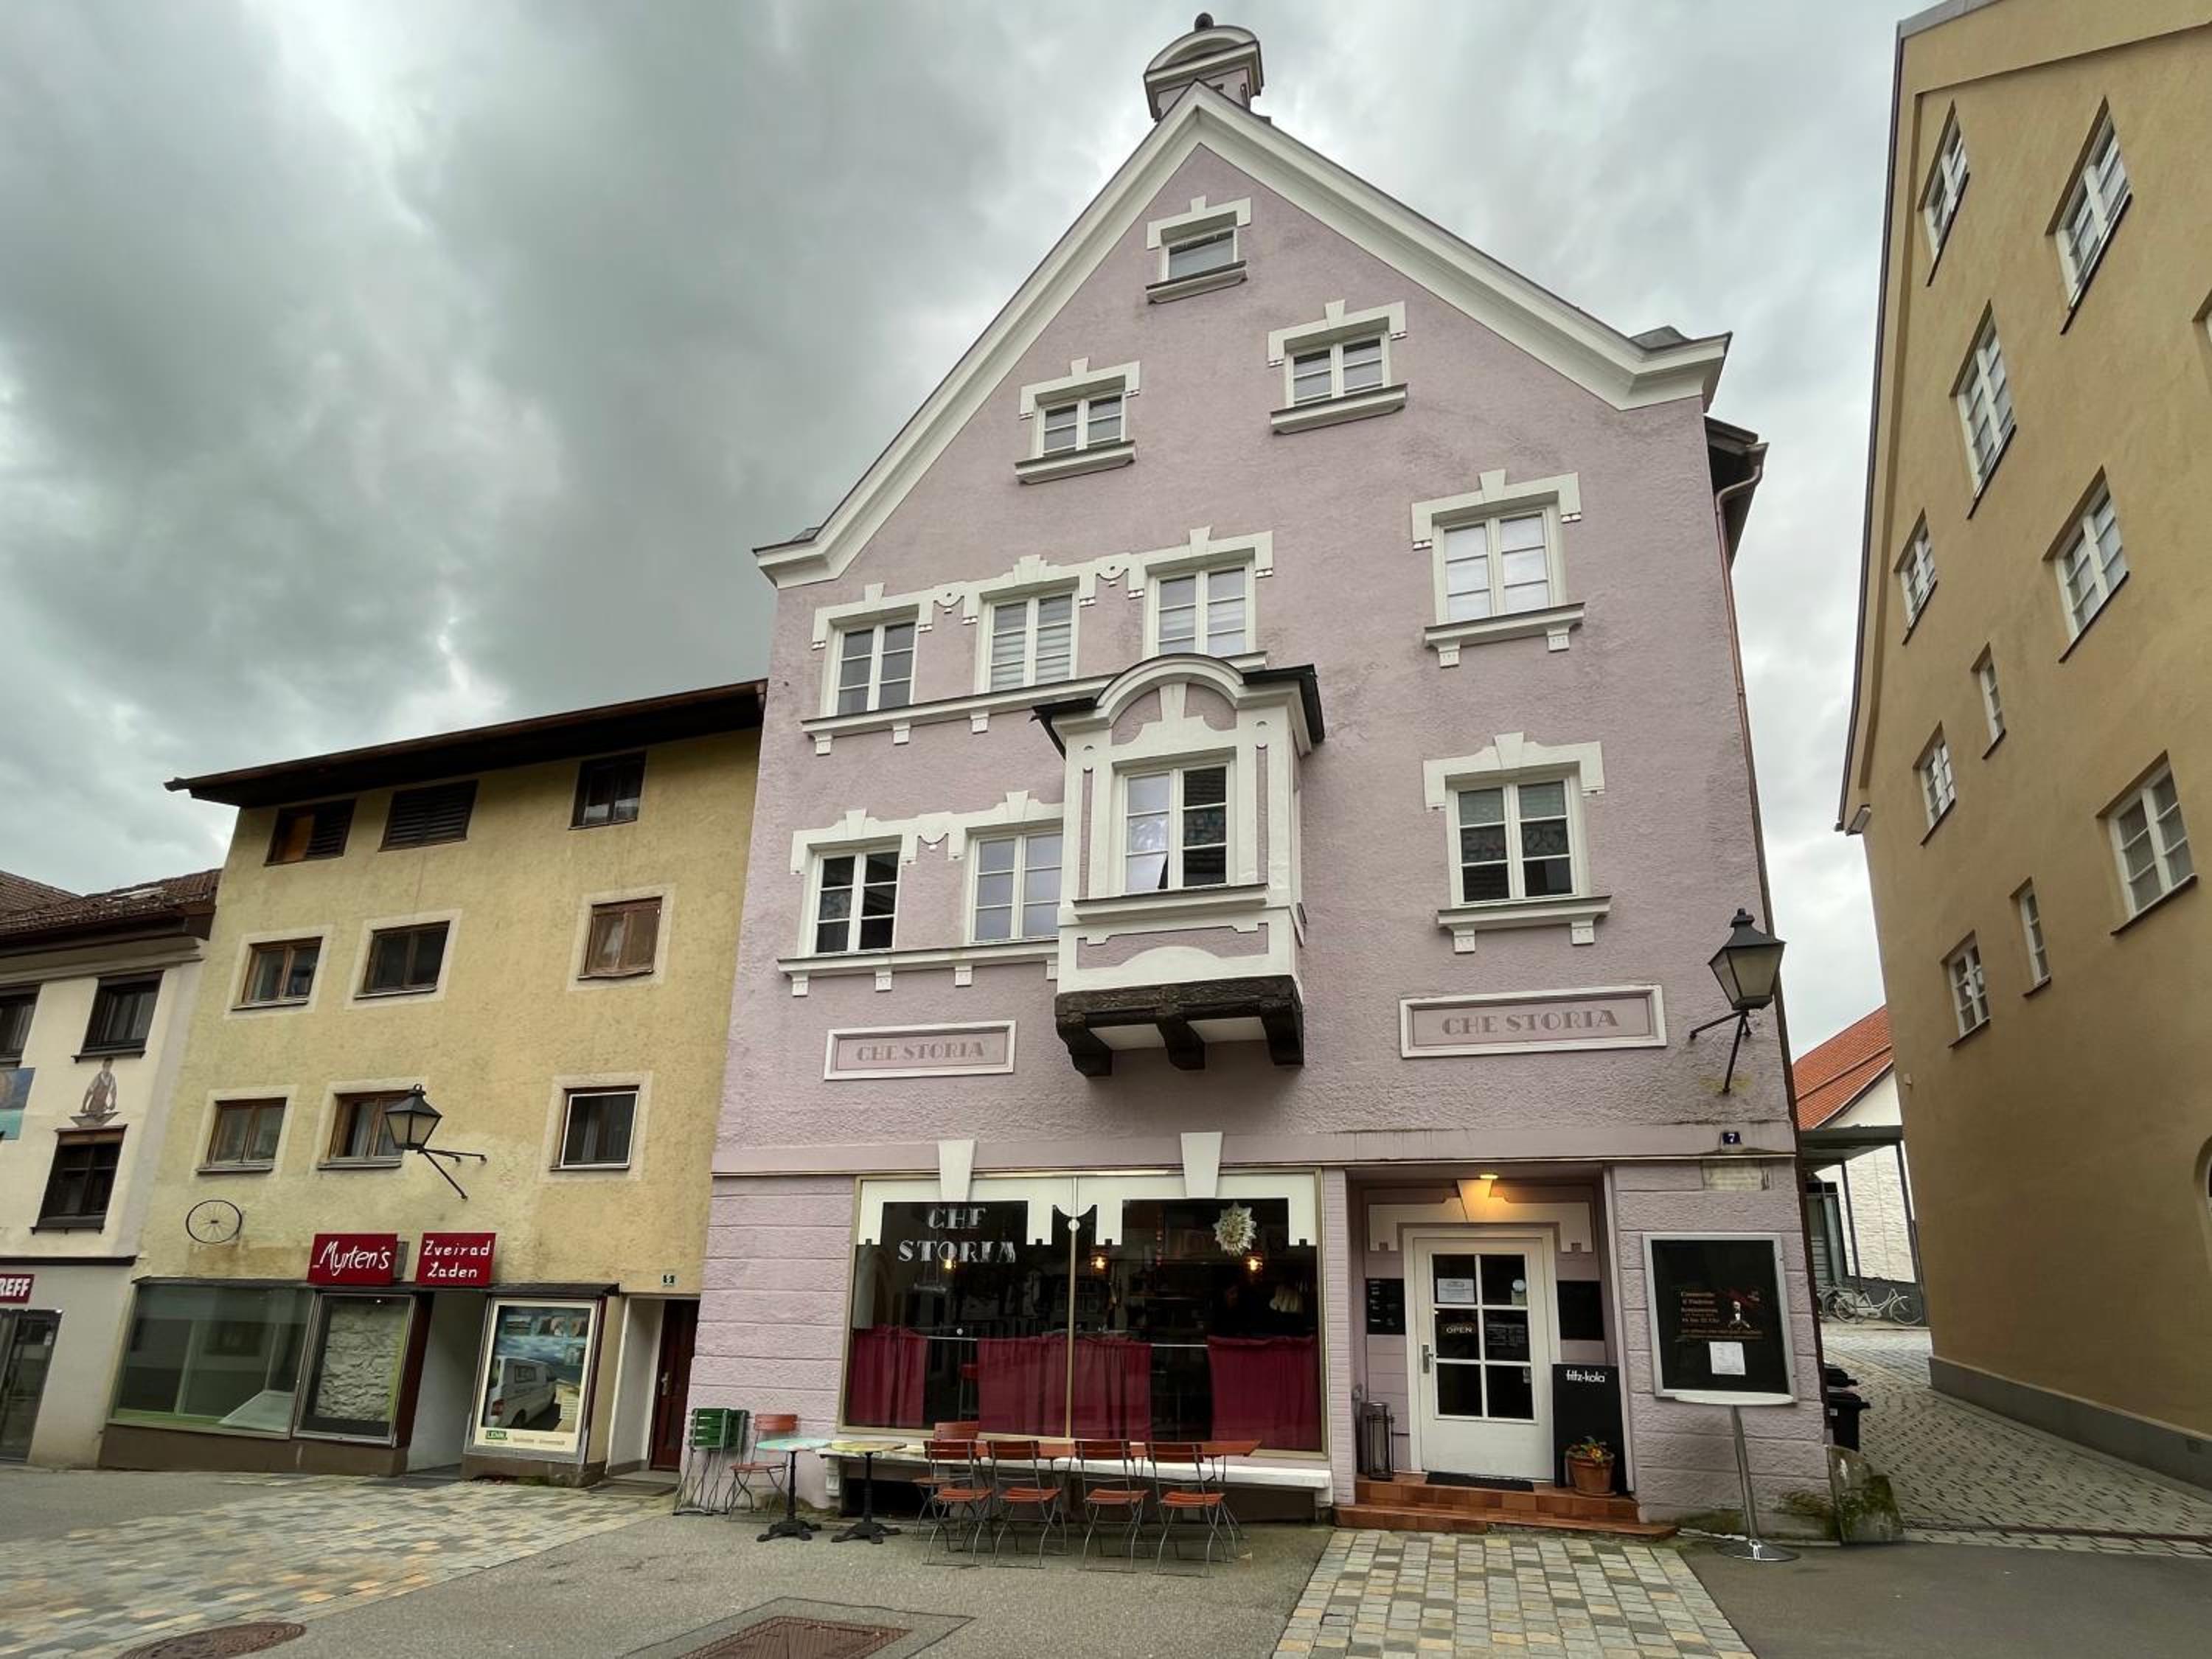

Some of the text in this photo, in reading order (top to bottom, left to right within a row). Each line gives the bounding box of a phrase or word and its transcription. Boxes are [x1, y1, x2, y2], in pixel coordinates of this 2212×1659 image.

[1441, 1009, 1619, 1034] CHE STORIA
[856, 1041, 985, 1062] CHE STORIA
[897, 1239, 1017, 1263] STORIA
